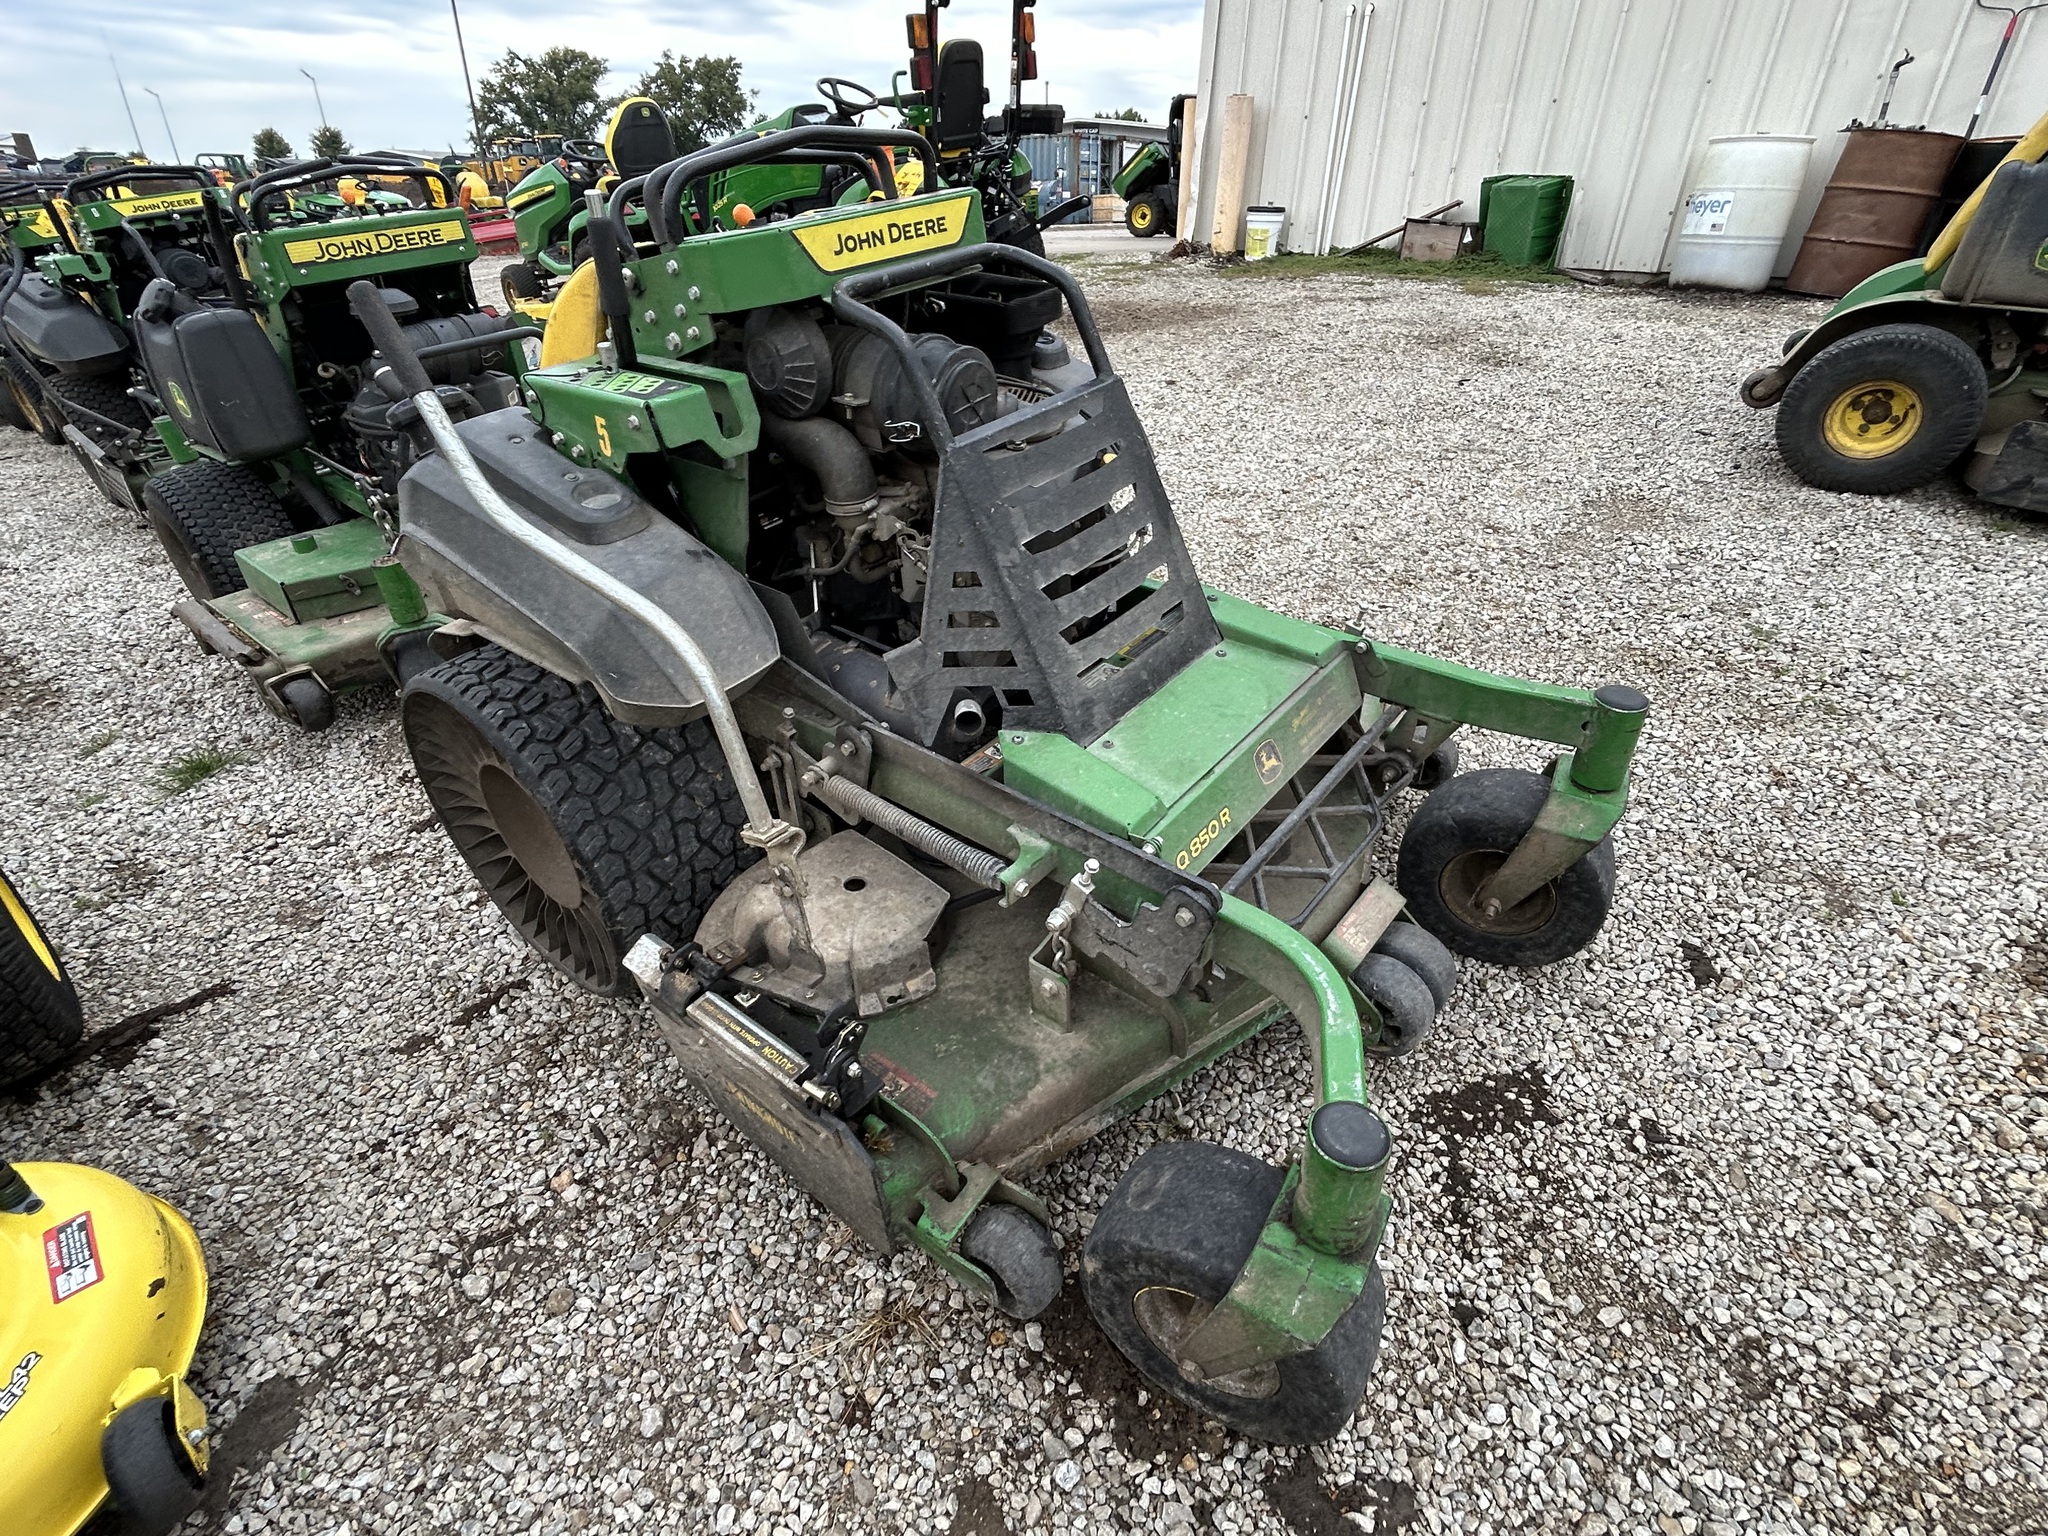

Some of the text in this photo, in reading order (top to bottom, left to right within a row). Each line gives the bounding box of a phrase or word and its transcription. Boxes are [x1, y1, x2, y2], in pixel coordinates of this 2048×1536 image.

[131, 197, 199, 214] JOHN DEERE
[314, 228, 445, 261] JOHN DEERE
[833, 216, 948, 256] JOHN DEERE
[594, 414, 612, 457] 5
[1189, 819, 1220, 858] 850
[1219, 807, 1232, 828] R
[739, 1029, 761, 1047] OPERATE
[761, 1045, 798, 1074] CAUTION
[11, 1351, 43, 1385] 42
[0, 1374, 29, 1422] EP
